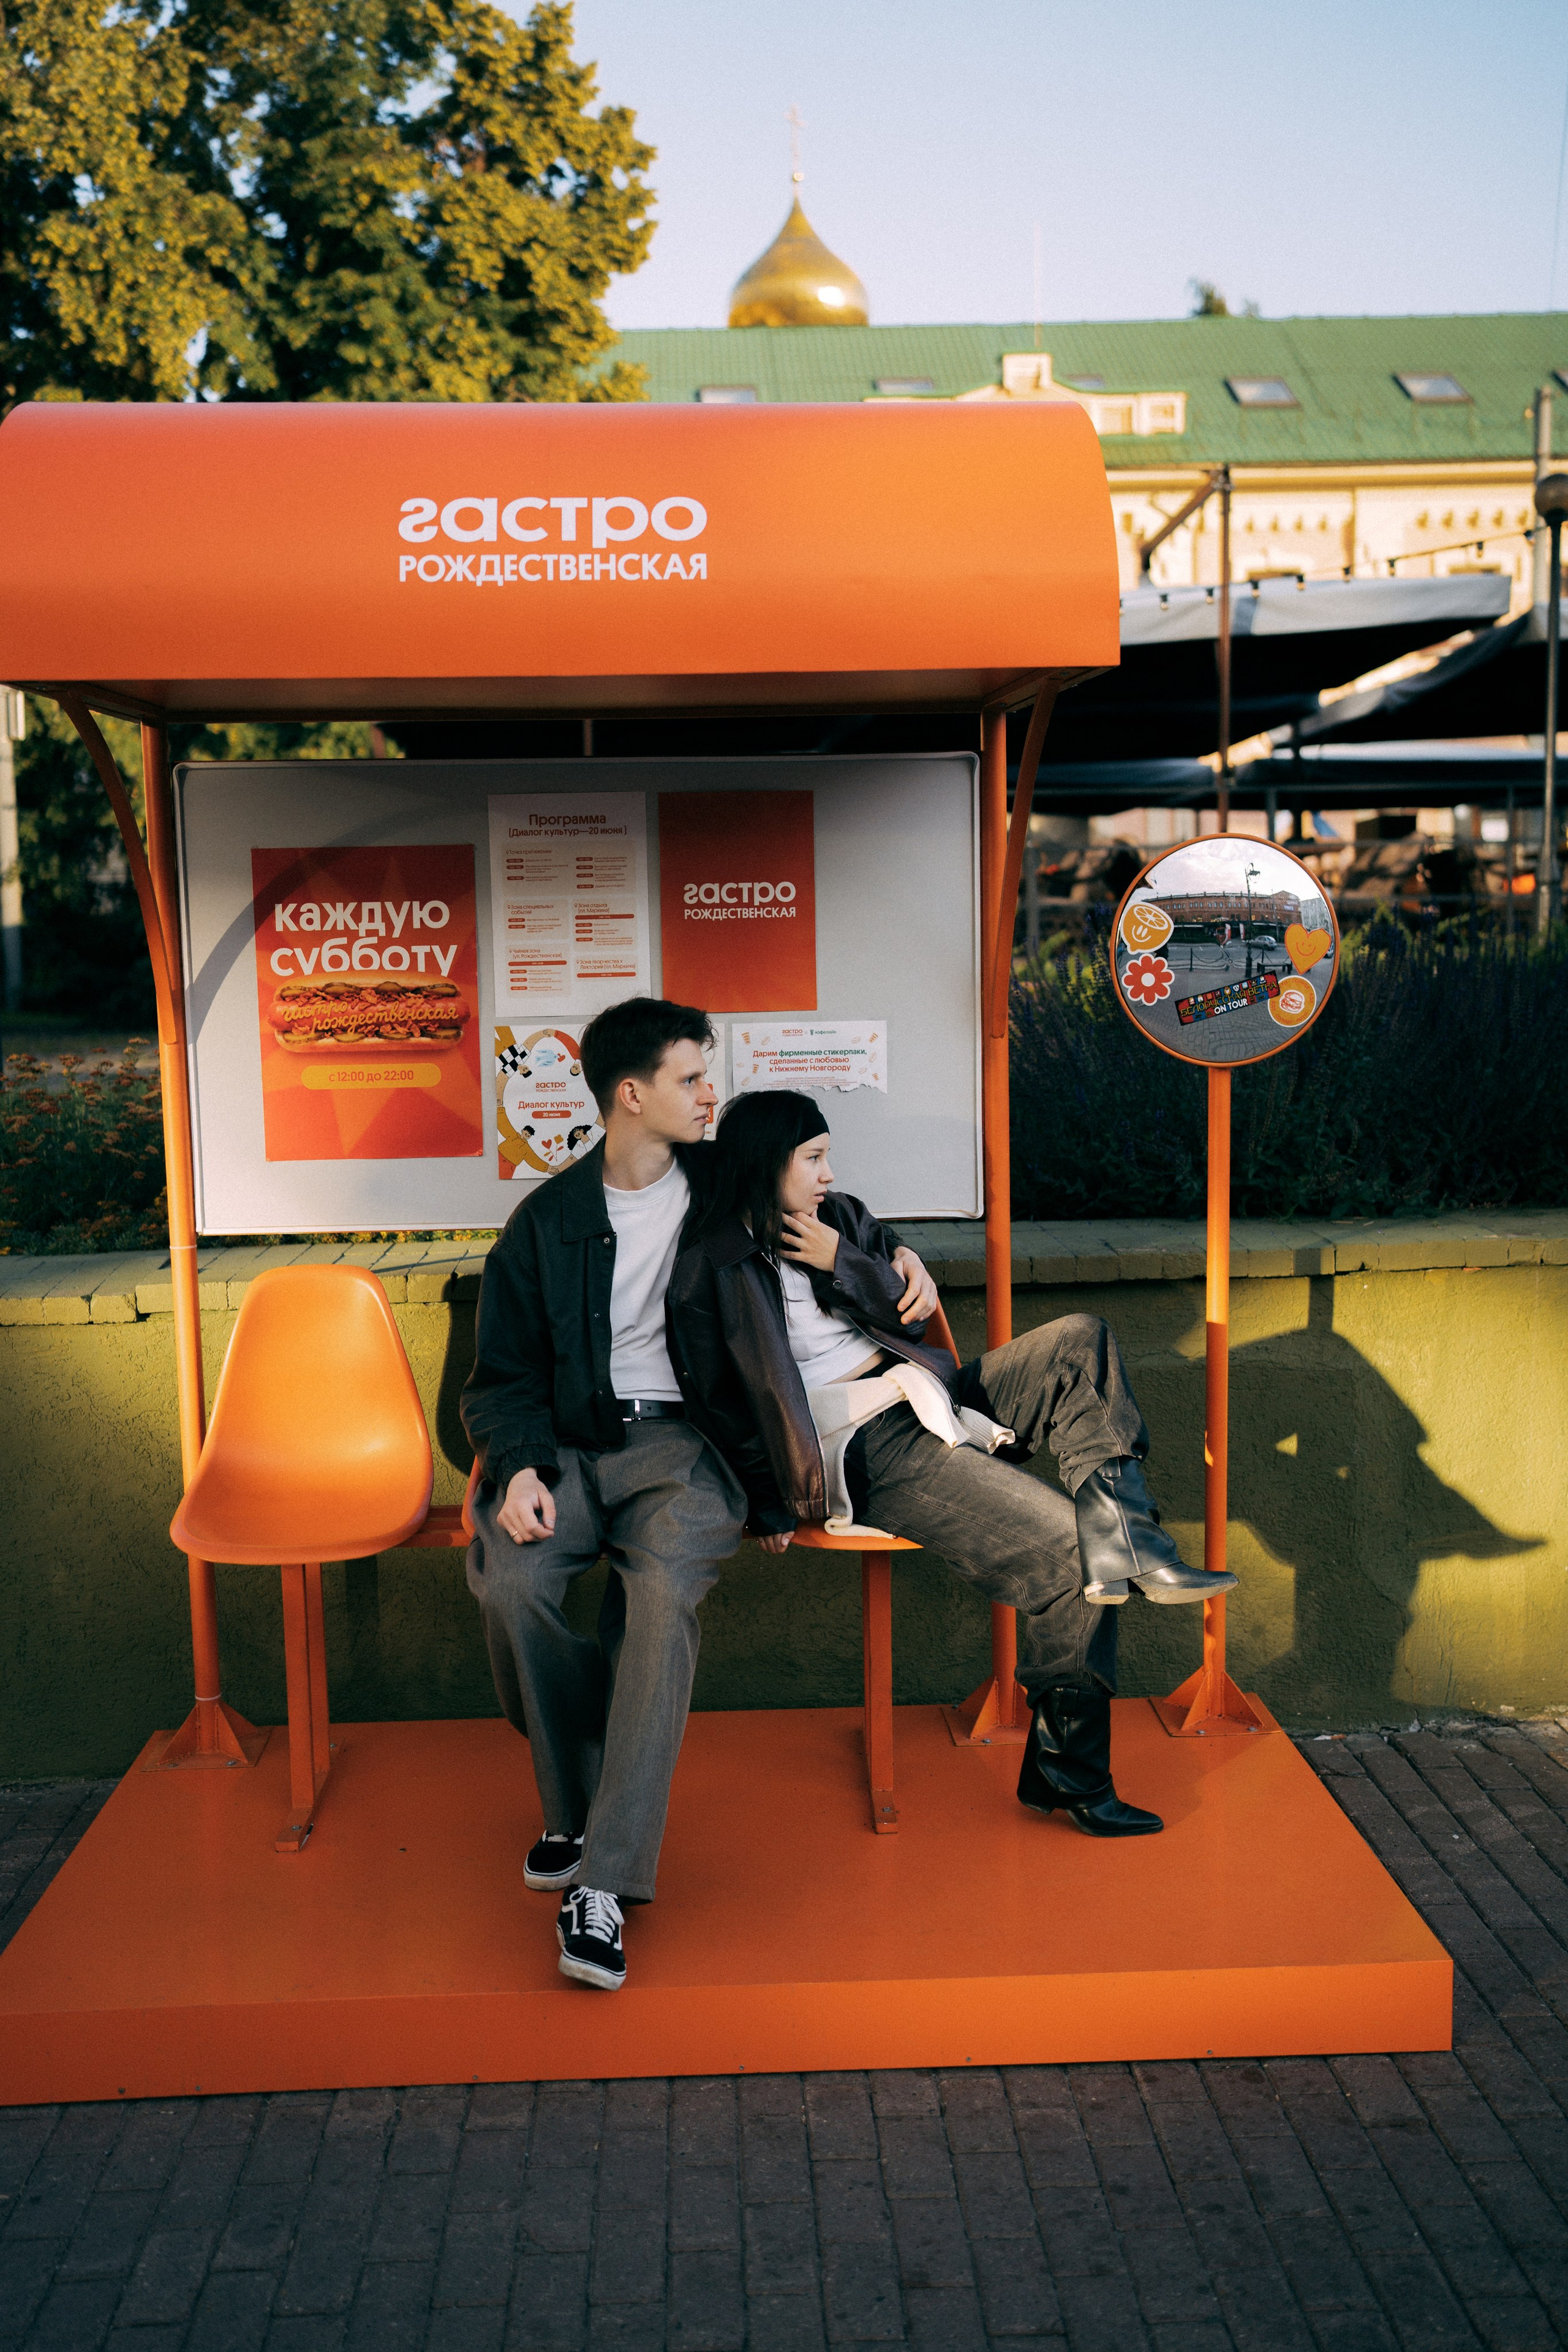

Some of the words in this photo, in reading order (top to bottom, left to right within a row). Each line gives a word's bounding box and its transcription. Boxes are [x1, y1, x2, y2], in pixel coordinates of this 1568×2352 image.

[398, 497, 707, 548] гастро
[399, 553, 707, 586] РОЖДЕСТВЕНСКАЯ
[529, 814, 606, 827] Программа
[684, 881, 796, 906] гастро
[275, 900, 450, 938] каждую
[684, 907, 796, 921] РОЖДЕСТВЕНСКАЯ
[270, 937, 458, 976] субботу
[282, 1001, 348, 1022] гастро
[1180, 990, 1246, 1017] БЕЛОРУССКАЯ
[1248, 981, 1277, 997] ВЕТКА
[1214, 1005, 1227, 1014] ON
[1227, 998, 1248, 1010] TOUR
[311, 1003, 459, 1035] рождественская
[337, 1071, 364, 1082] 12:00
[367, 1073, 382, 1084] до
[384, 1070, 415, 1081] 22:00
[518, 1101, 549, 1110] Диалог
[551, 1101, 585, 1109] культур
